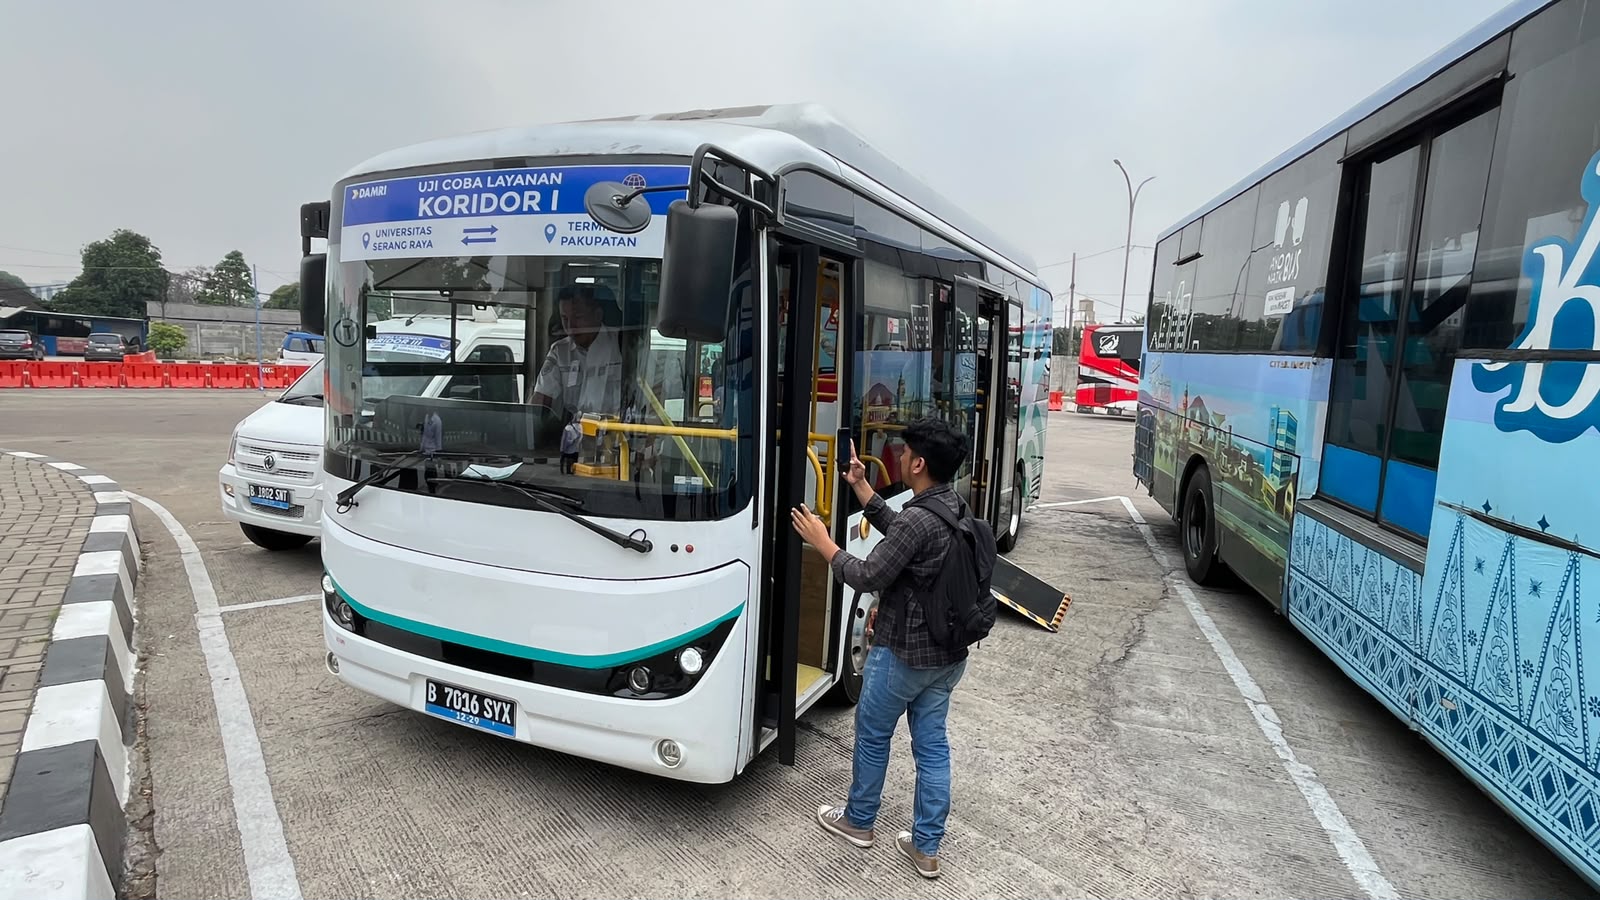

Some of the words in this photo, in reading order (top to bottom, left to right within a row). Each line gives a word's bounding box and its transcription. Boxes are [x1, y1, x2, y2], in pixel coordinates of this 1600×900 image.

[418, 181, 438, 192] UJI
[442, 177, 483, 191] COBA
[487, 172, 563, 187] LAYANAN
[359, 185, 387, 198] DAMRI
[418, 190, 541, 217] KORIDOR
[551, 189, 559, 211] I
[375, 226, 432, 238] UNIVERSITAS
[568, 221, 606, 232] TERM
[372, 241, 407, 251] SERANG
[409, 239, 433, 249] RAYA
[560, 236, 637, 247] PAKUPATAN
[1282, 248, 1302, 282] BUS
[249, 485, 255, 497] B
[428, 682, 437, 702] B
[444, 687, 480, 715] 7016
[483, 697, 511, 724] SYX
